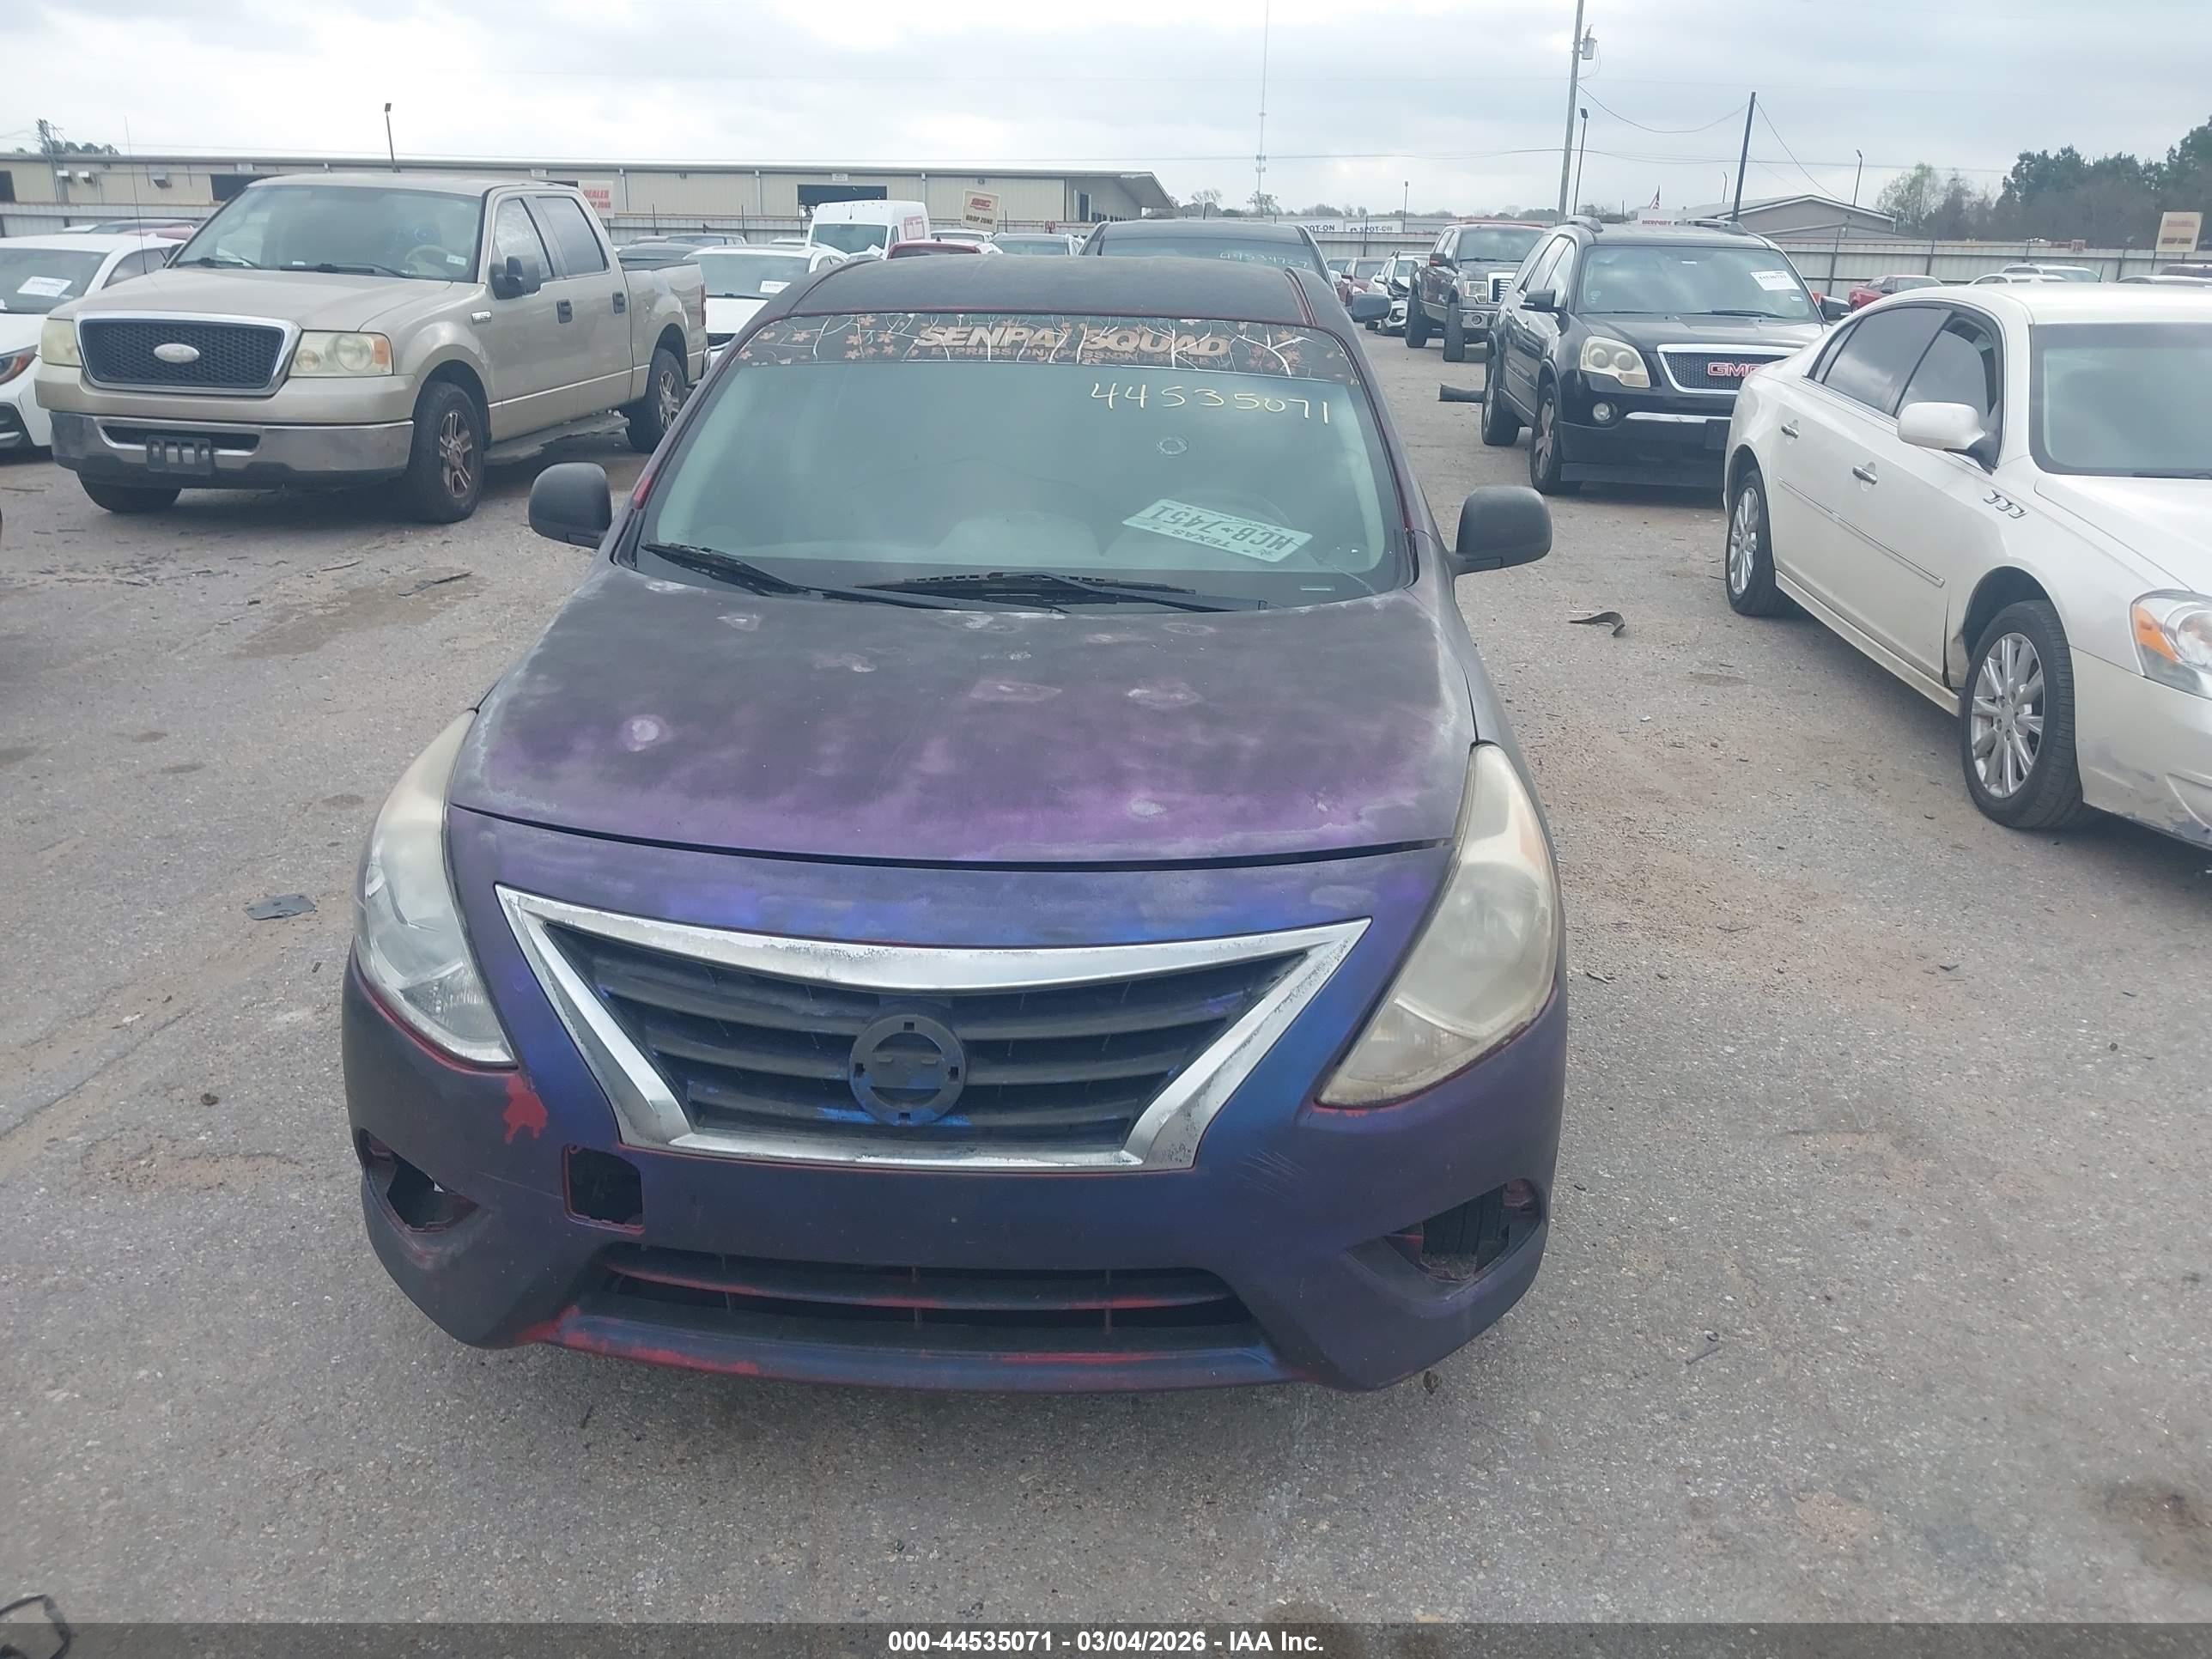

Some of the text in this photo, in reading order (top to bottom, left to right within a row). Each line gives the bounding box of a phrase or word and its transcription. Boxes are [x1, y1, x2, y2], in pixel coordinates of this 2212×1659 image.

[1082, 328, 1231, 357] SQUAD
[1091, 382, 1330, 425] 44535071
[1170, 528, 1231, 548] TEXAS
